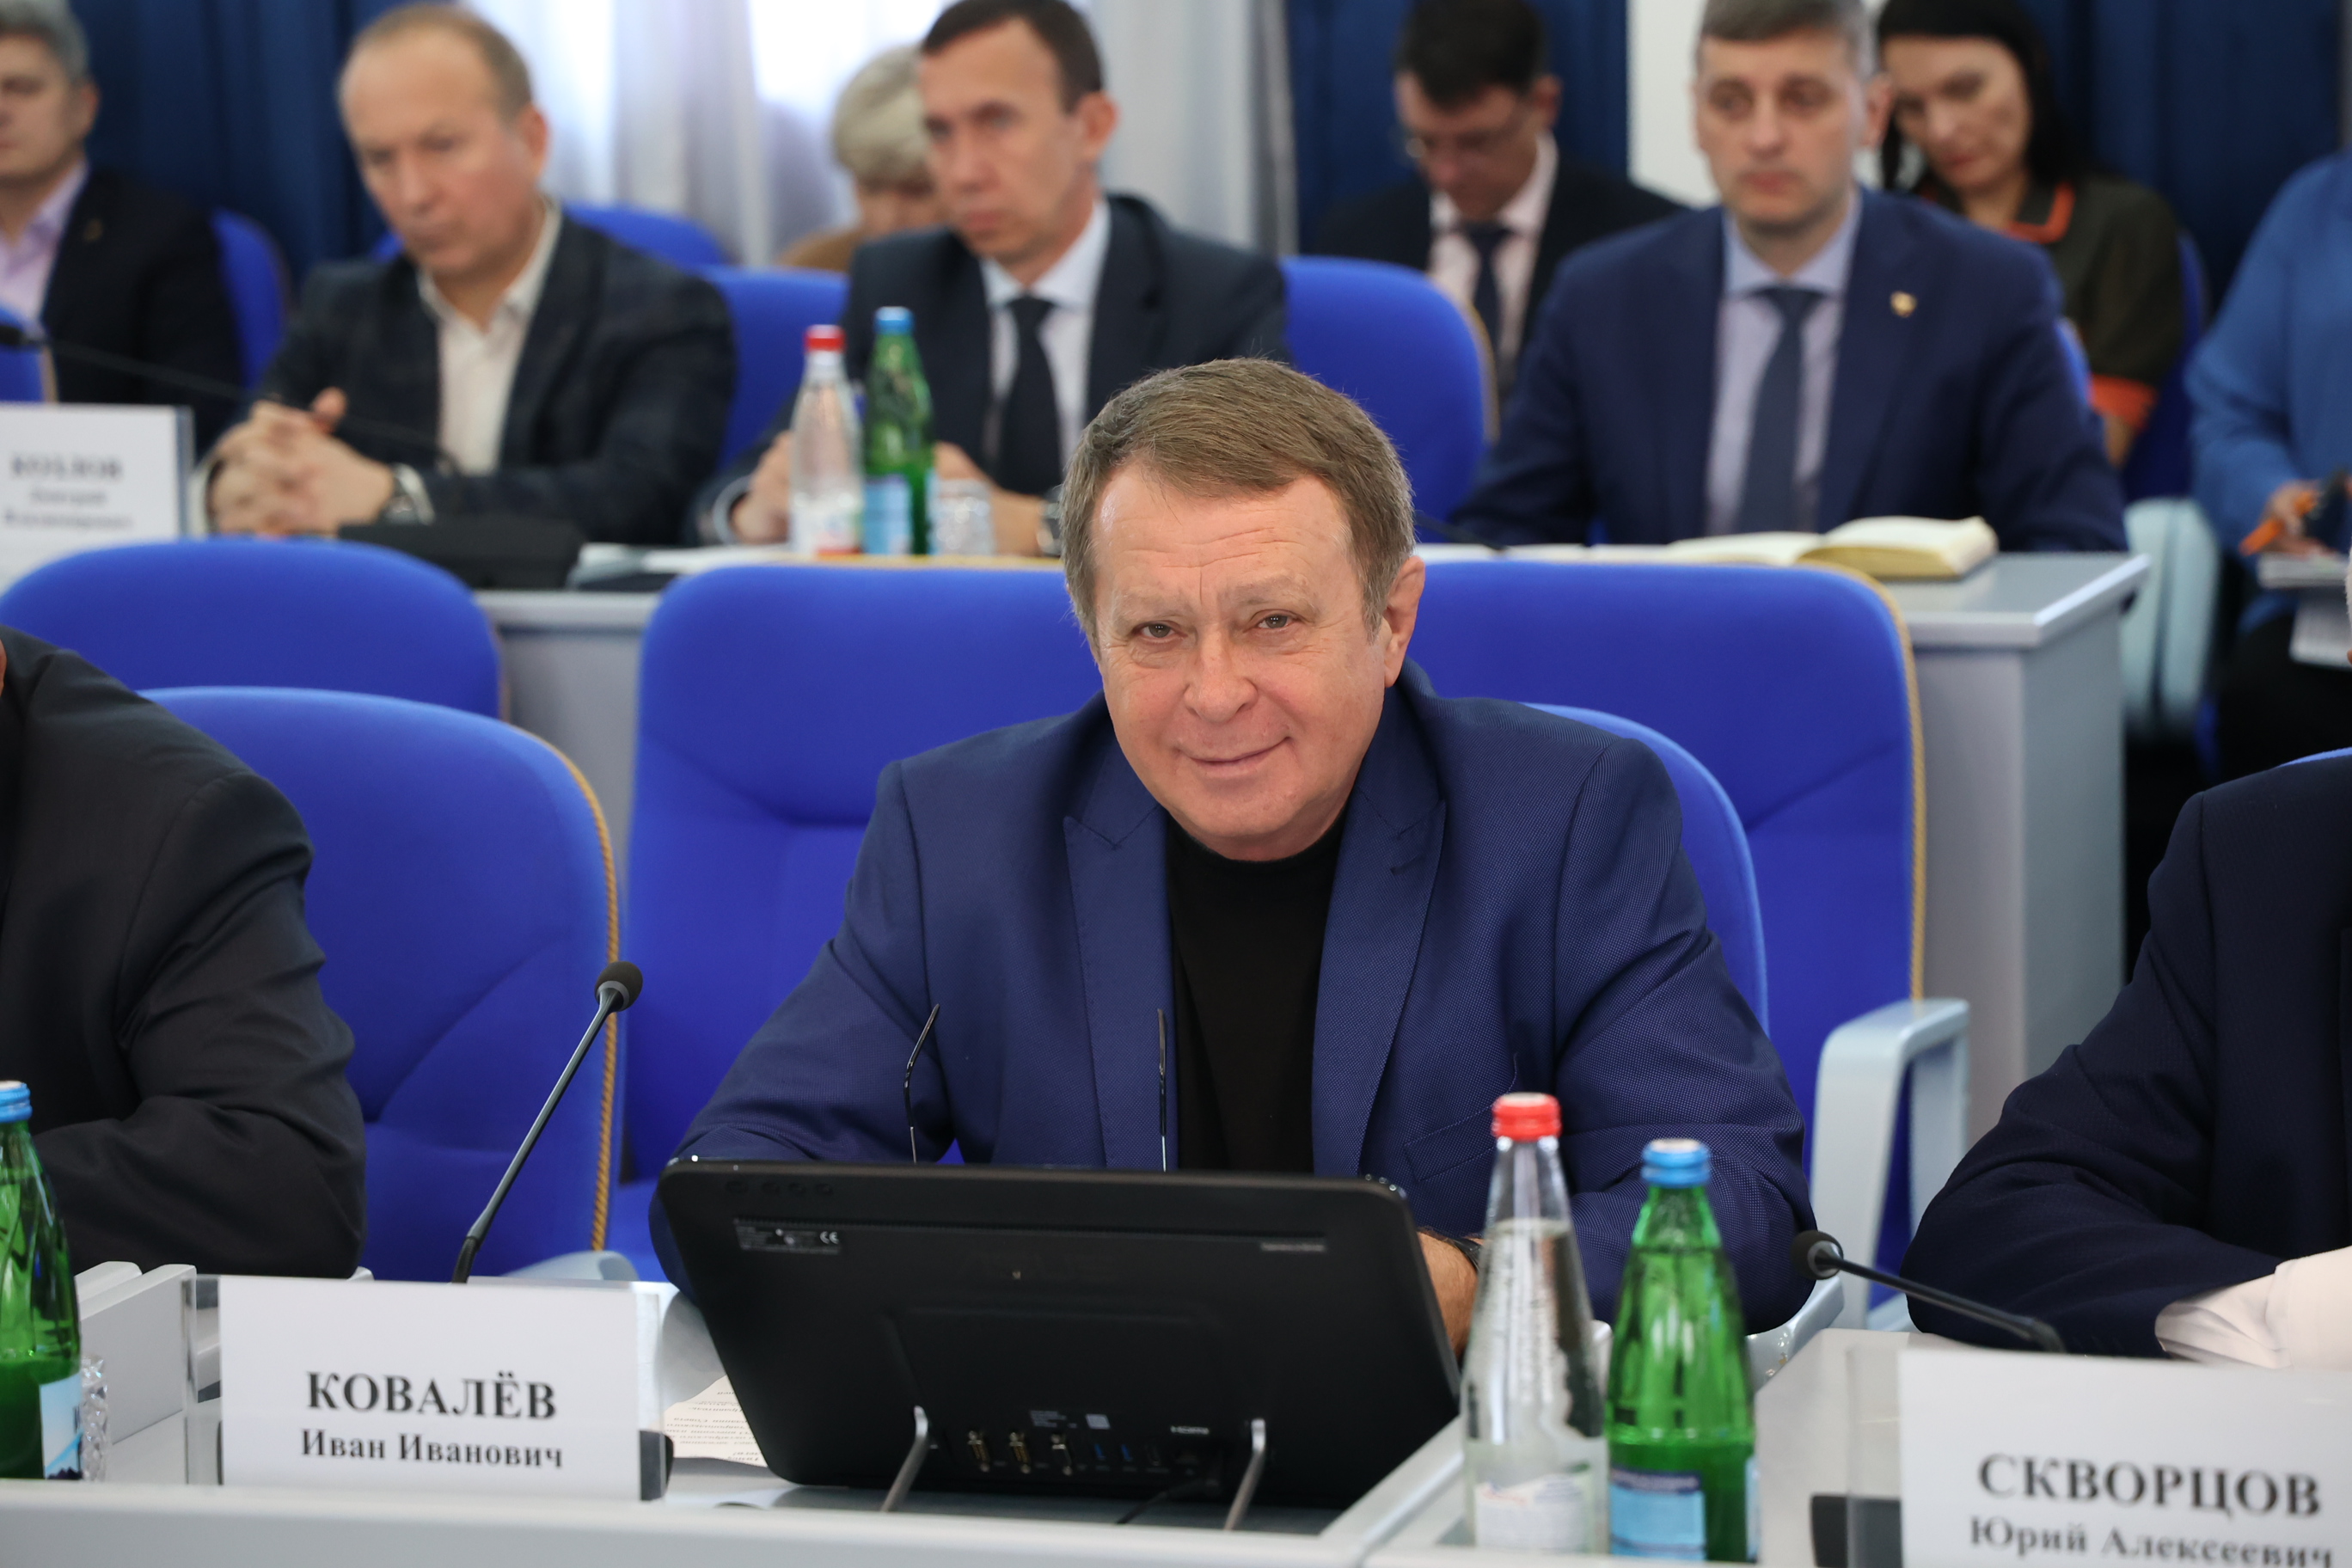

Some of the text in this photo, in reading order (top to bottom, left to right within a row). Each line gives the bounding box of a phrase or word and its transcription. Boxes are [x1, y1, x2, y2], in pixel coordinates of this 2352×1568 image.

[306, 1370, 558, 1420] КОВАЛЁВ
[301, 1428, 563, 1468] Иван Иванович
[1977, 1453, 2321, 1518] СКВОРЦОВ
[1970, 1515, 2334, 1568] Юрий Алексеевич
